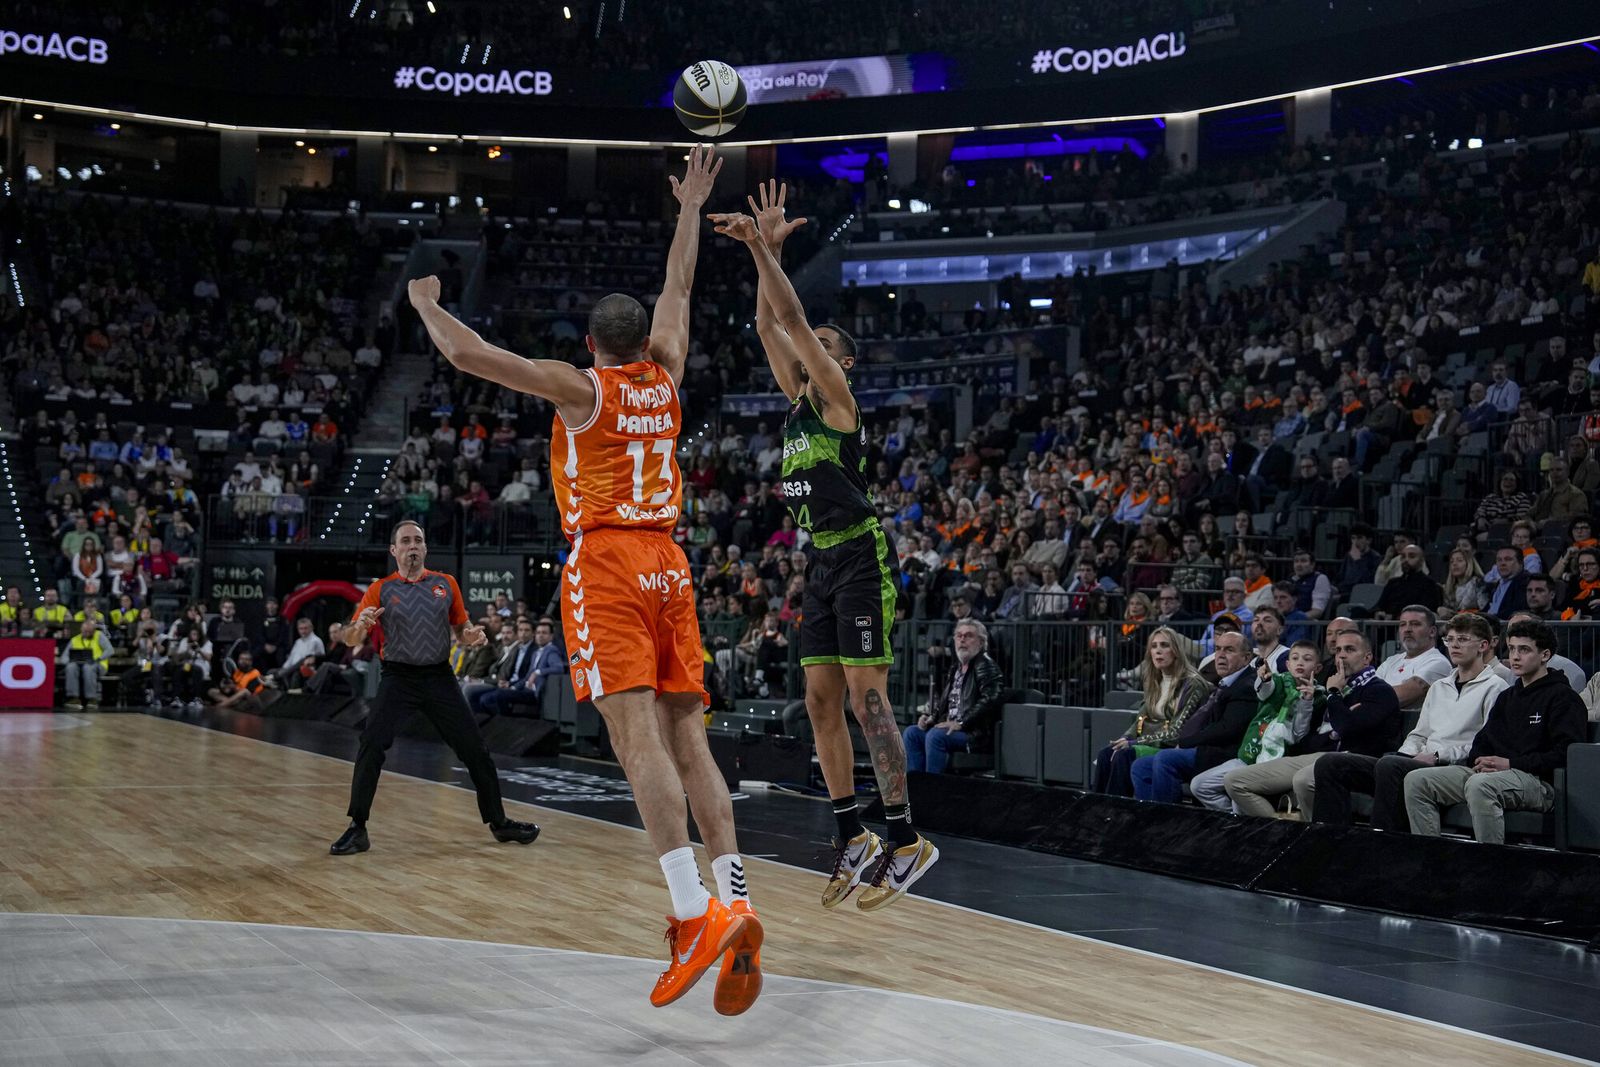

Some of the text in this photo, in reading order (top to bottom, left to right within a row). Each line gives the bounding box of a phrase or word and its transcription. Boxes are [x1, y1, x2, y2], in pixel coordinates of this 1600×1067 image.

[0, 29, 109, 64] paACB
[394, 66, 553, 97] #CopaACB
[743, 71, 829, 93] pa del Rey
[619, 381, 672, 409] THMPON
[616, 411, 674, 434] PAMEA
[626, 438, 674, 505] 13
[212, 583, 264, 599] SALIDA
